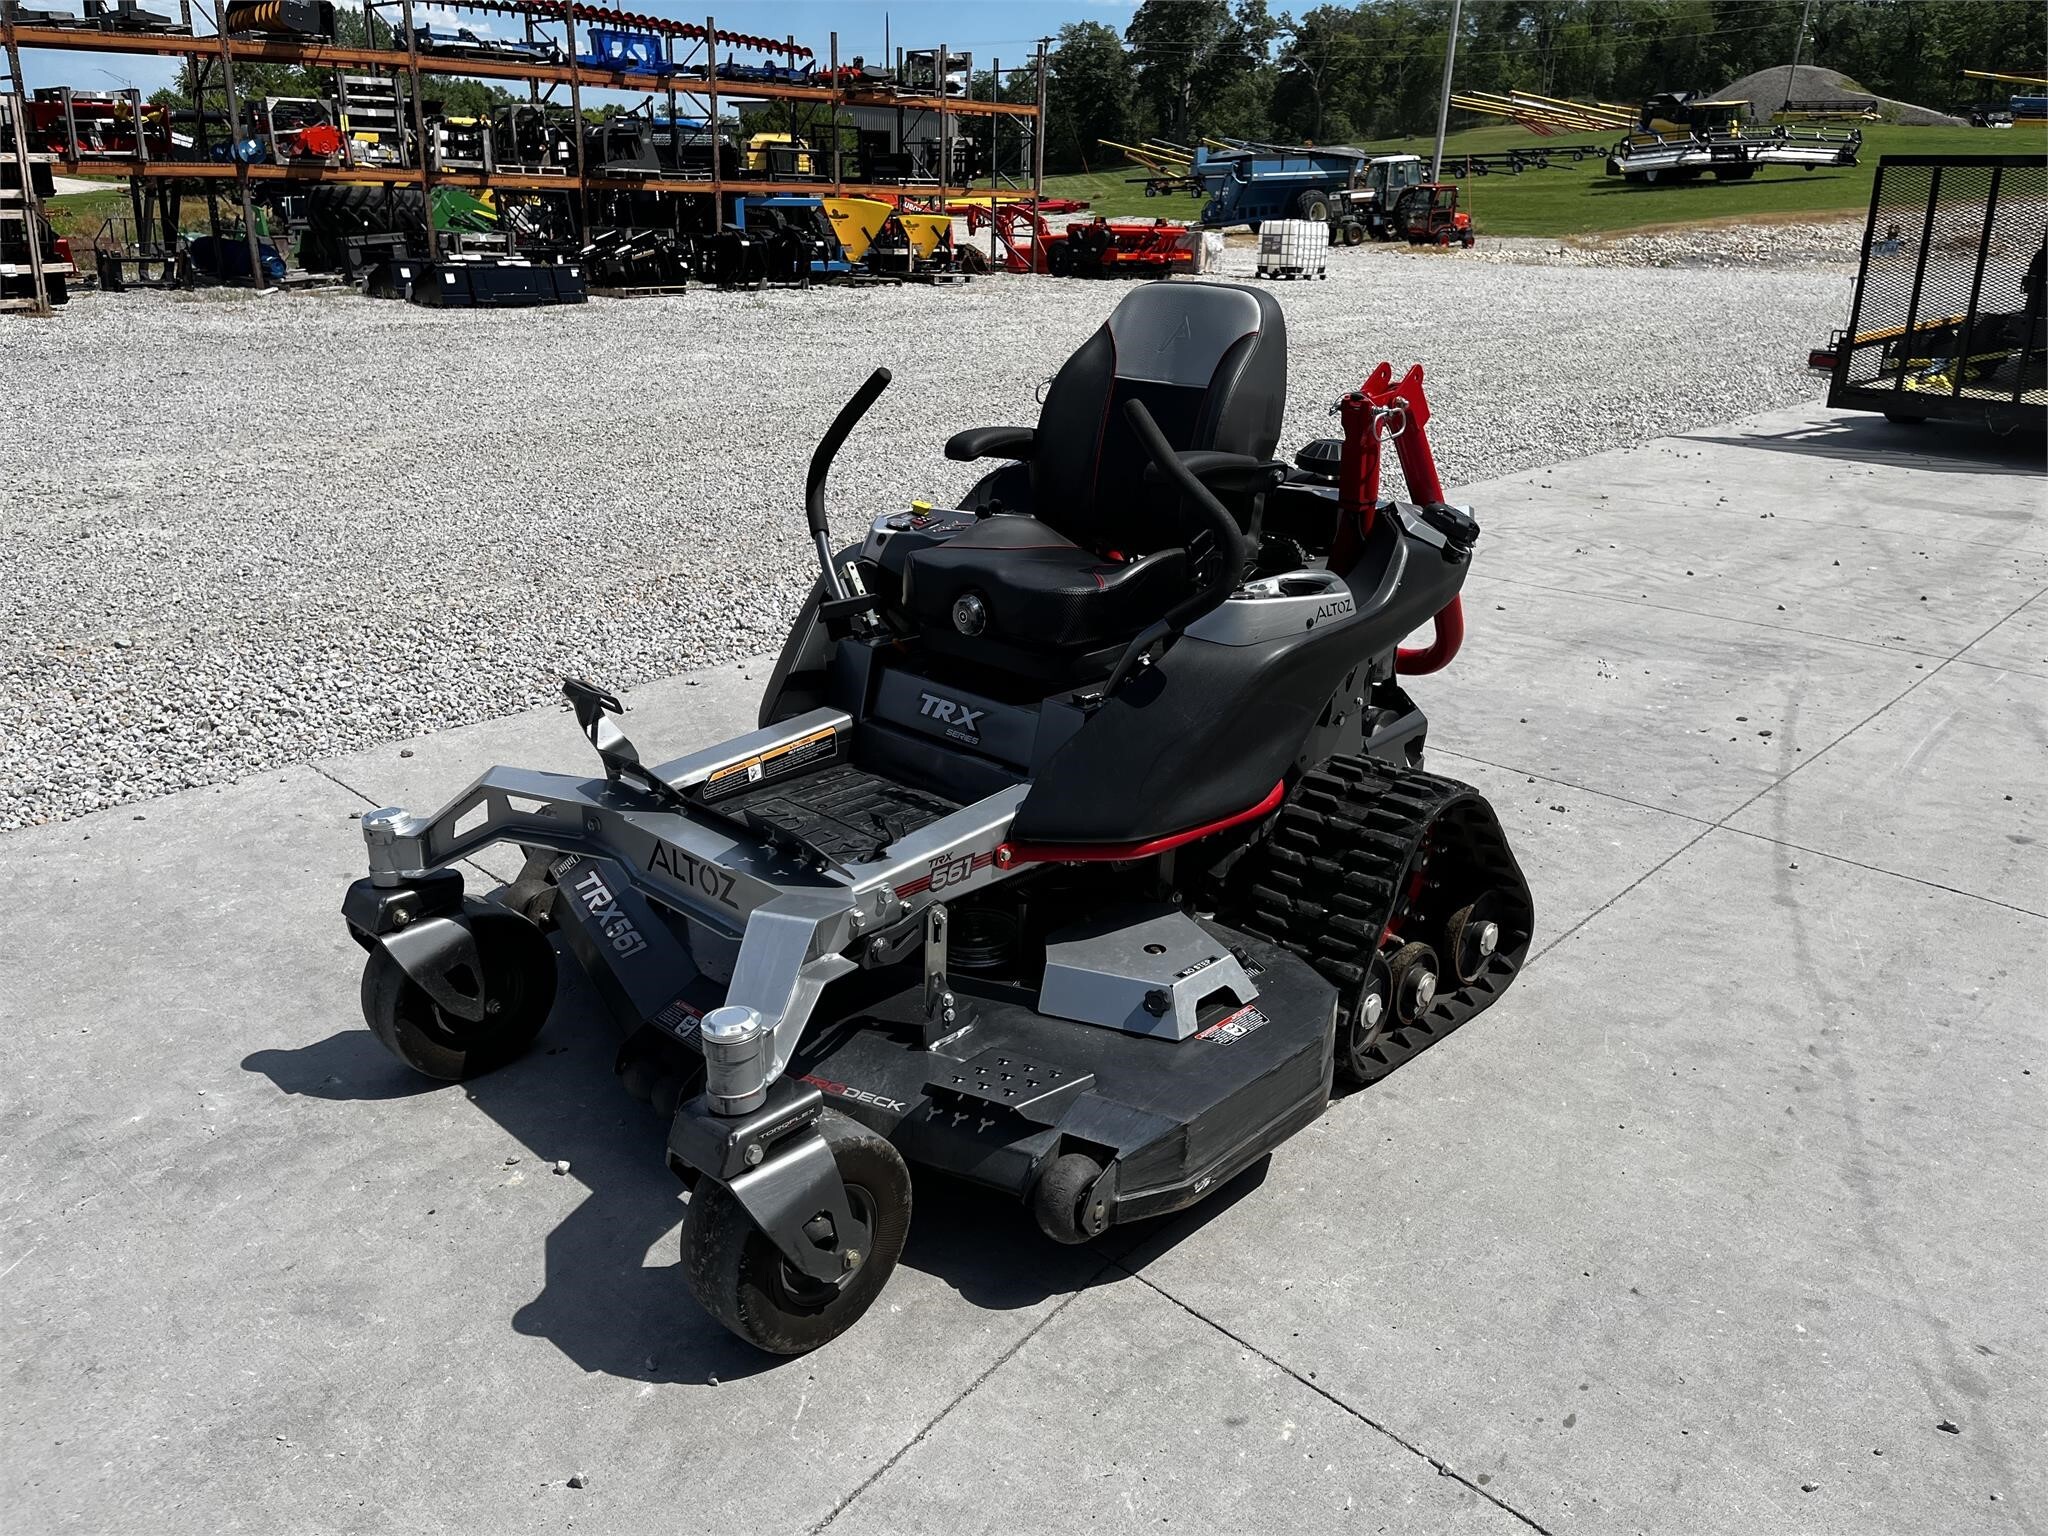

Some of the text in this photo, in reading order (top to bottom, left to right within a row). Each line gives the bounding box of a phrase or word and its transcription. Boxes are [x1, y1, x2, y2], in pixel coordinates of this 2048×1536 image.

[1315, 599, 1353, 624] ALTOZ
[921, 693, 985, 731] TRX
[945, 728, 979, 745] SERIES
[647, 839, 739, 910] ALTOZ
[928, 851, 954, 868] TRX
[929, 854, 975, 892] 561
[574, 870, 648, 959] TRX561
[1182, 959, 1211, 976] NO STEP
